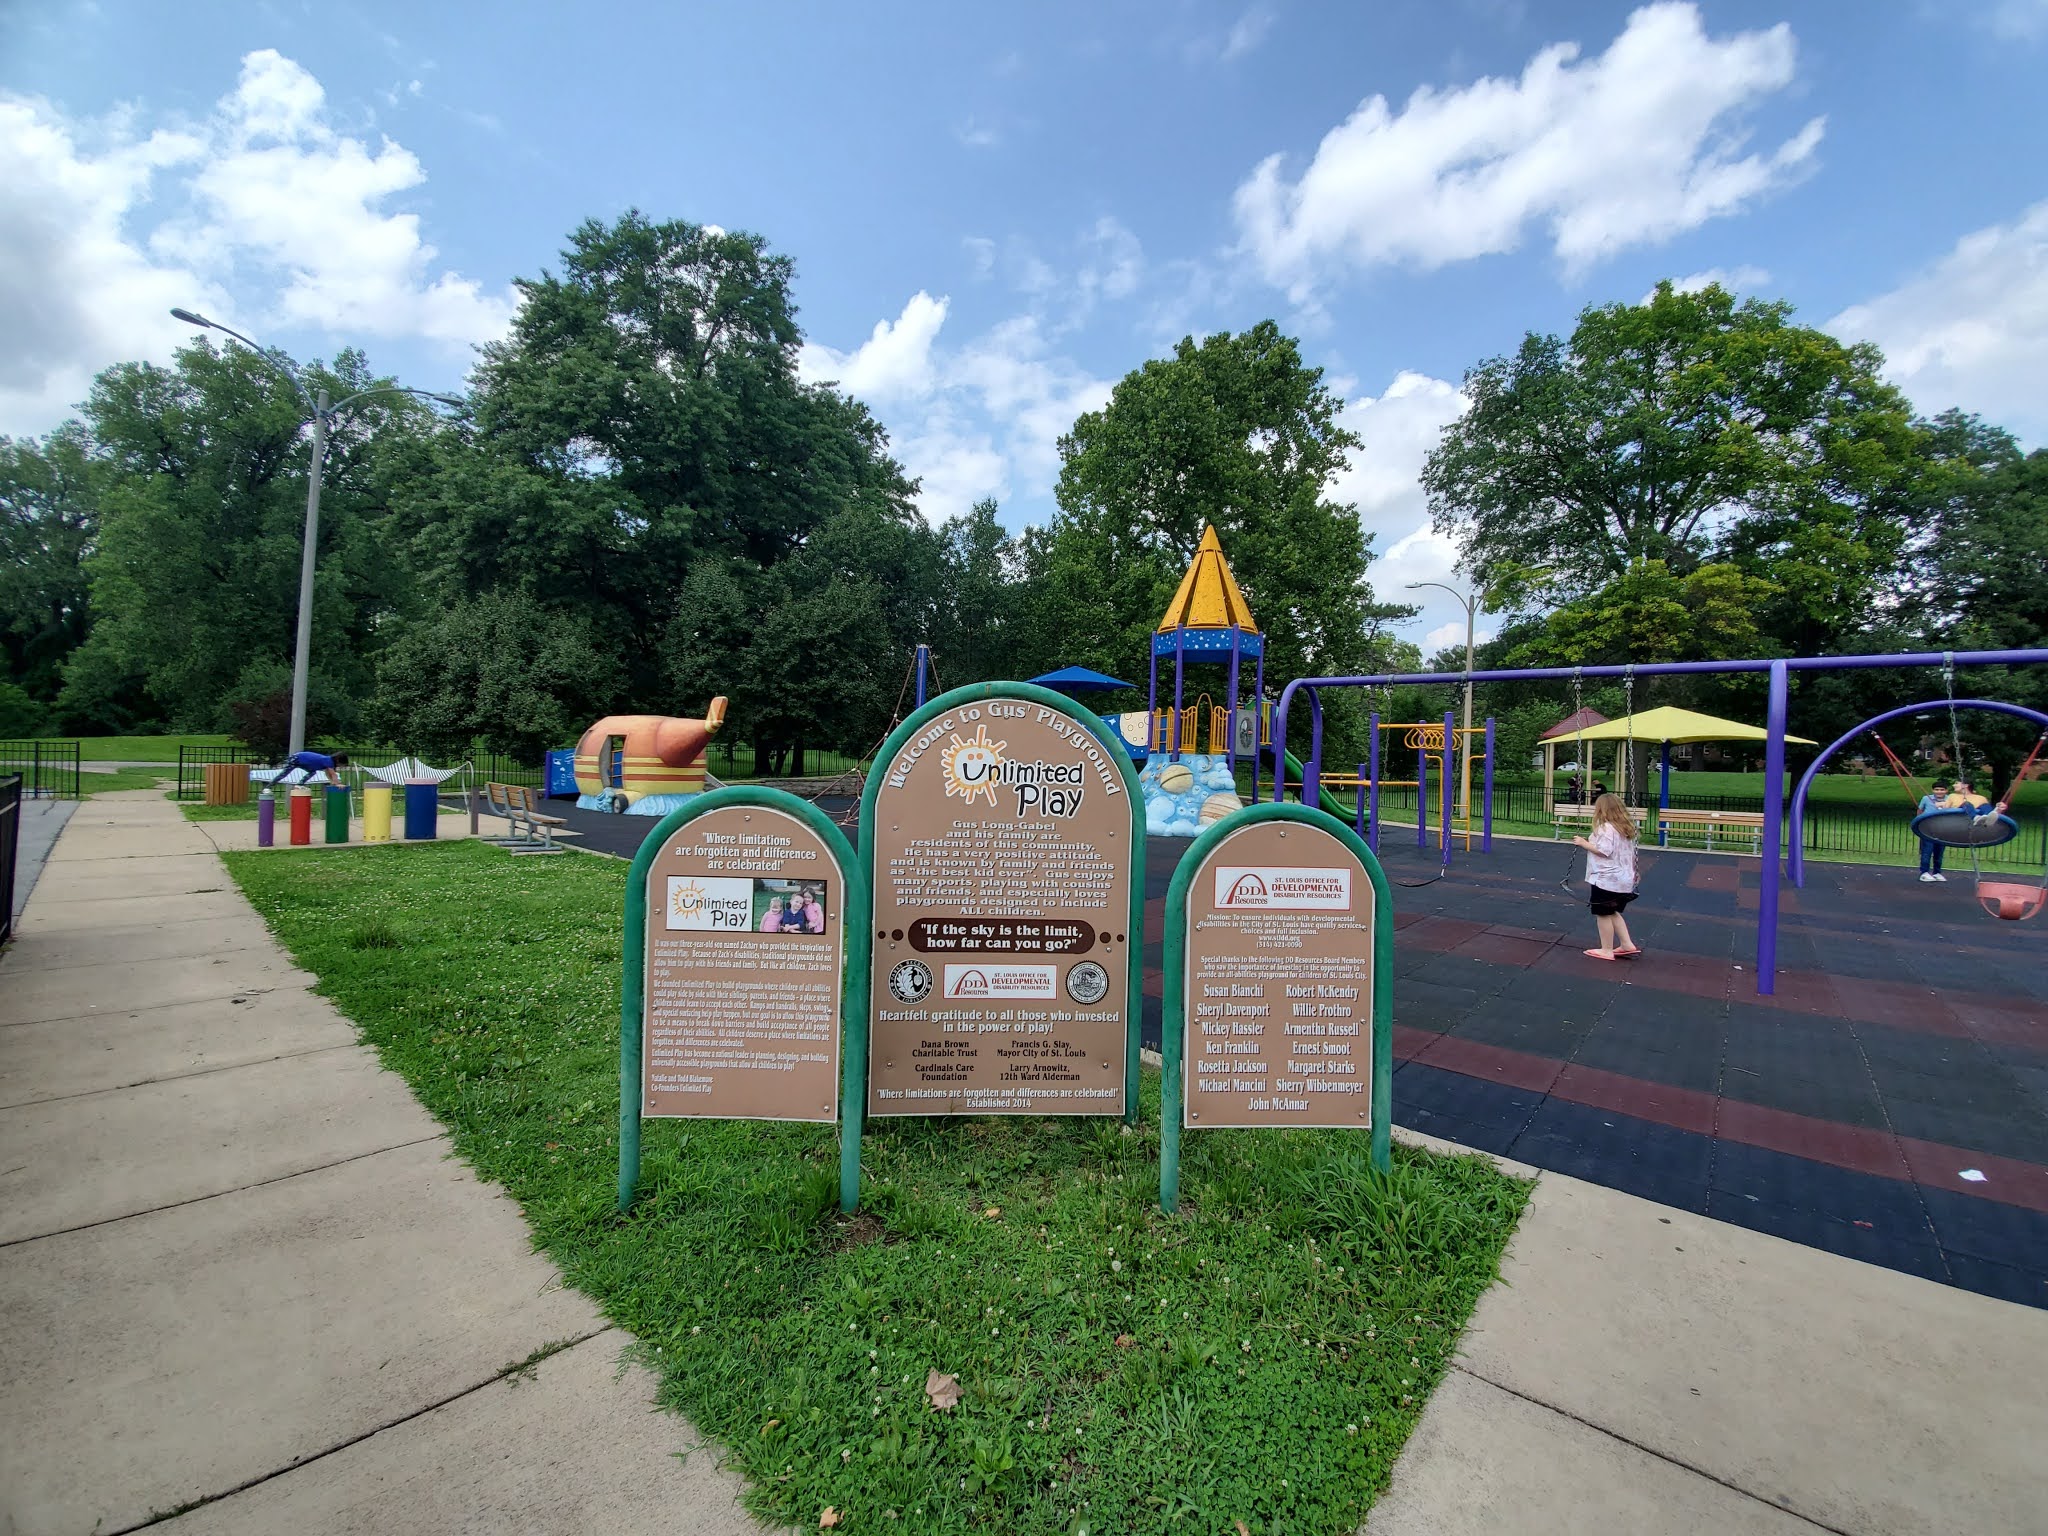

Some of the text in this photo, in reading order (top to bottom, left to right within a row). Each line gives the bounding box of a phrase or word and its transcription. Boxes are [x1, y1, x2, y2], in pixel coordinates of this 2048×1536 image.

[888, 716, 955, 789] Welcome
[959, 708, 981, 723] to
[1036, 709, 1121, 796] Playground
[963, 761, 1083, 784] Unlimited
[1015, 784, 1083, 817] Play
[953, 820, 1056, 831] Gus Long-Gabel
[739, 834, 791, 846] limitations
[946, 830, 971, 838] and
[975, 830, 994, 839] his
[998, 831, 1037, 841] family
[911, 839, 1095, 851] residents of this community.
[676, 846, 816, 860] are forgotten and differences
[905, 848, 922, 856] He
[925, 849, 948, 857] has
[964, 851, 991, 859] very
[995, 850, 1045, 860] positive
[1049, 851, 1102, 860] attitude
[708, 861, 724, 869] are
[890, 858, 1114, 870] and is known by family and friends
[1239, 886, 1260, 895] DD
[1272, 884, 1344, 892] DEVELOPMENTAL
[682, 898, 747, 909] Unlimited
[896, 896, 1107, 908] playgrounds designed to include
[1235, 896, 1267, 904] Resources
[960, 907, 1045, 916] ALL children.
[711, 910, 747, 927] Play
[921, 924, 1083, 938] "If the sky is the limit,
[927, 937, 1076, 951] how far can you go?"
[964, 980, 983, 988] DD
[960, 987, 988, 995] Resources
[1204, 984, 1264, 997] Susan Bianchi
[1286, 985, 1359, 1001] Robert McKendry
[879, 1010, 1119, 1023] Heartfelt gratitude to all those who invested
[1197, 1003, 1270, 1019] Sheryl Davenport
[1293, 1004, 1351, 1017] Willie Prothro
[943, 1022, 1054, 1034] in the power of play!
[1202, 1022, 1264, 1038] Mickey Hassler
[1284, 1023, 1359, 1036] Armentha Russell
[921, 1040, 969, 1048] Dana Brown
[1053, 1040, 1071, 1050] Slay,
[1206, 1041, 1260, 1054] Ken Franklin
[1293, 1041, 1351, 1054] Ernest Smoot
[912, 1049, 977, 1057] Charitable Trust
[997, 1049, 1020, 1059] Mayor
[1022, 1049, 1037, 1059] City
[915, 1064, 974, 1072] Cardinals Care
[1010, 1064, 1070, 1074] Larry Arnowitz,
[1198, 1060, 1267, 1073] Rosetta Jackson
[1288, 1060, 1355, 1076] Margaret Starks
[921, 1073, 967, 1081] Foundation
[1000, 1073, 1080, 1081] 12th Ward Alderman
[1199, 1079, 1266, 1092] Michael Mancini
[1276, 1079, 1363, 1095] Sherry Wibbenmeyer
[905, 1089, 947, 1098] limitations
[949, 1091, 961, 1099] are
[963, 1088, 999, 1101] forgotten
[1001, 1088, 1015, 1098] and
[1017, 1089, 1059, 1098] differences
[1061, 1090, 1073, 1098] are
[966, 1099, 1031, 1108] Established 2014
[1248, 1098, 1309, 1110] John McAnnar
